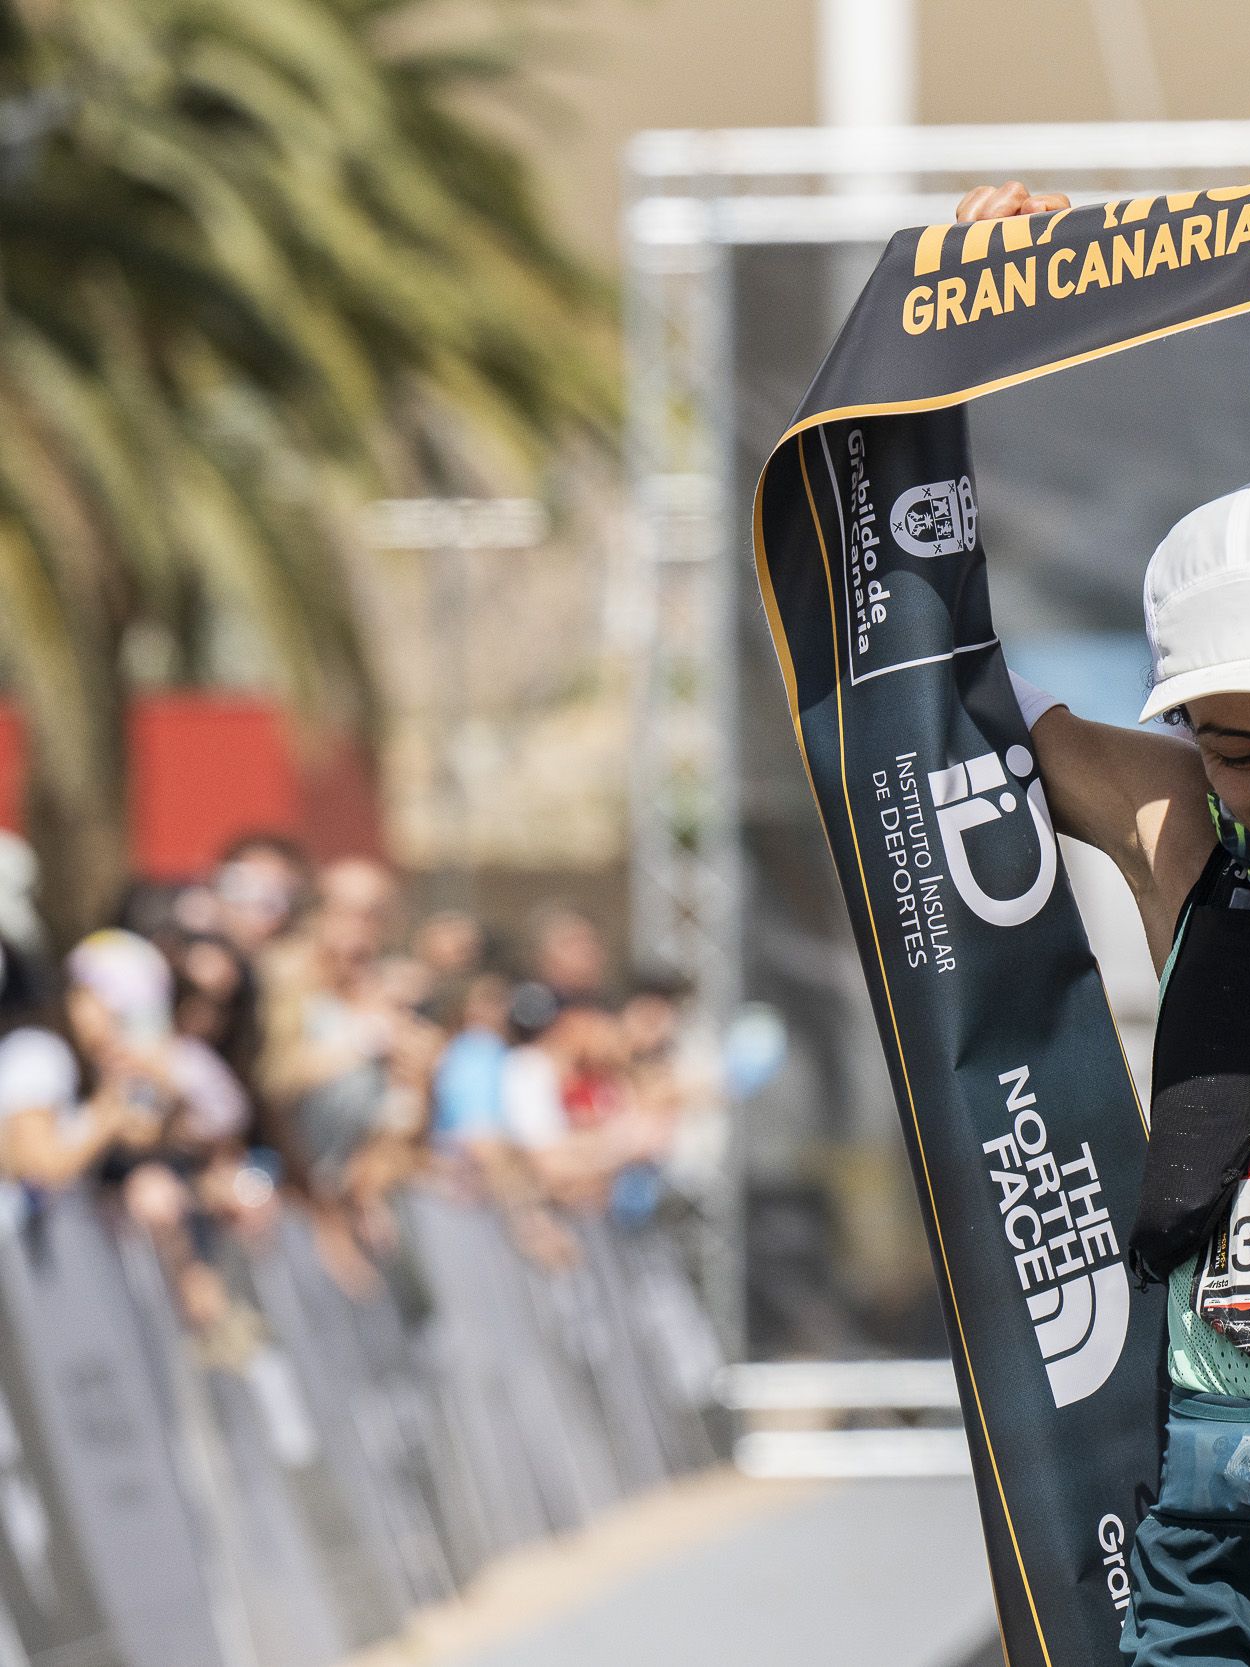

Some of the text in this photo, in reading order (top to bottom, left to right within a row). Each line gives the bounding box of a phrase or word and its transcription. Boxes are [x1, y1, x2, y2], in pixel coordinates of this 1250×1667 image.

[902, 255, 1036, 336] GRAN
[850, 521, 871, 655] Canaria
[867, 580, 891, 624] de
[872, 770, 928, 969] DE DEPORTES
[895, 751, 956, 973] INSTITUTO INSULAR
[982, 1132, 1055, 1291] FACE
[998, 1064, 1085, 1277] NORTH
[1060, 1141, 1120, 1265] THE
